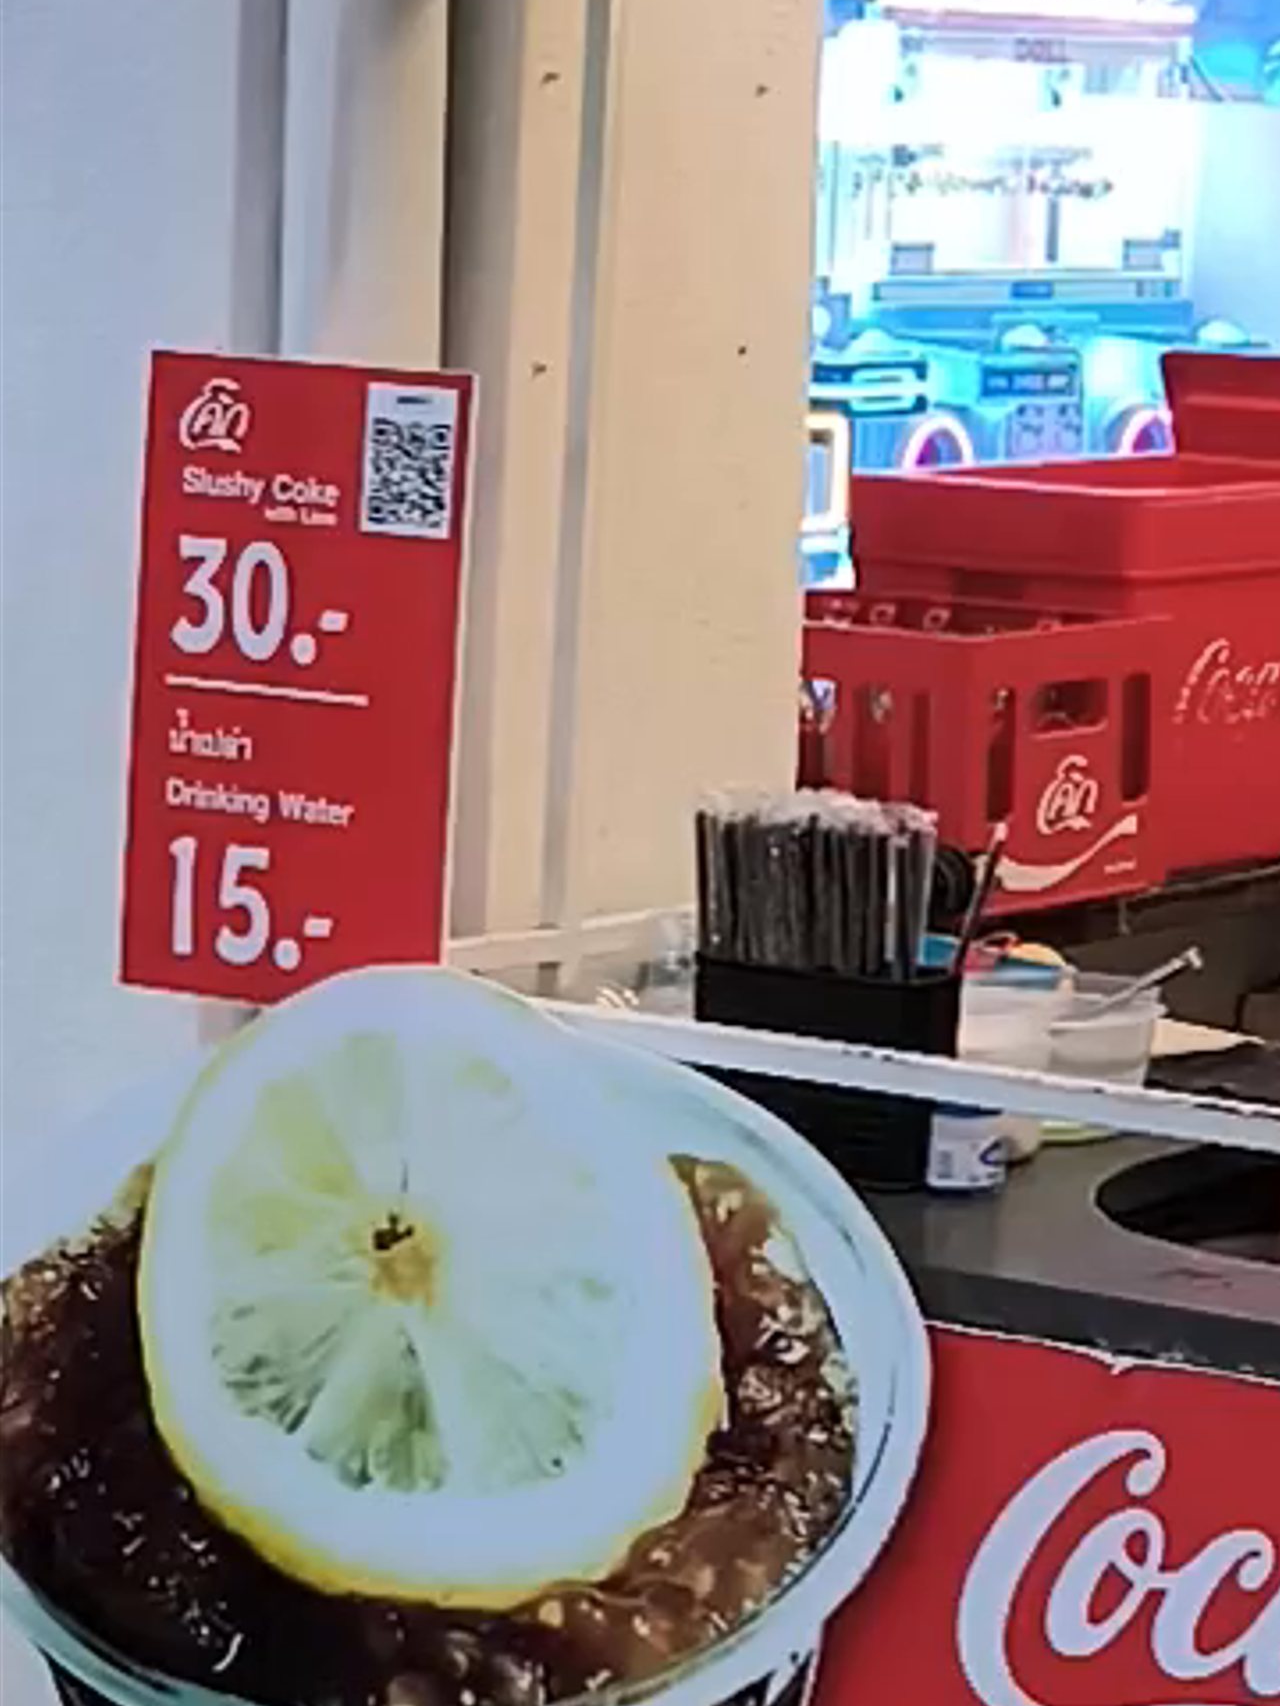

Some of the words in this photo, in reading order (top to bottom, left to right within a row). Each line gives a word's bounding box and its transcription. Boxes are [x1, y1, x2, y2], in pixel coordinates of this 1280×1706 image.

[181, 462, 264, 504] Slushy
[271, 473, 340, 508] Coke
[165, 776, 271, 823] Drinking
[278, 789, 355, 827] Water
